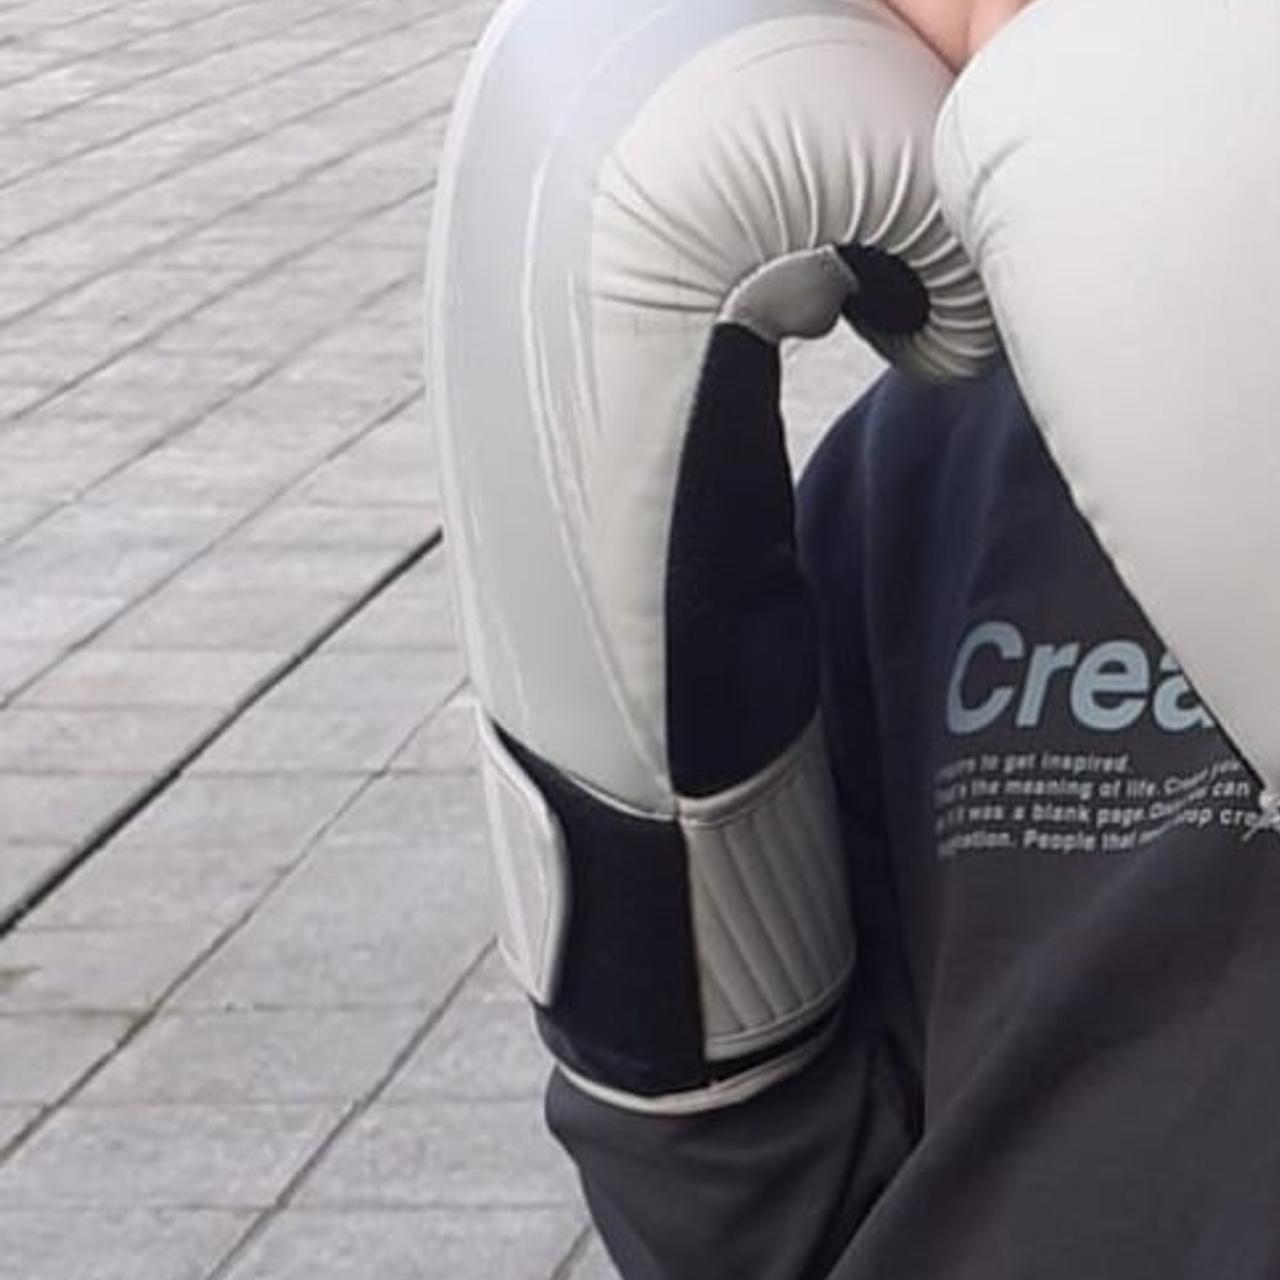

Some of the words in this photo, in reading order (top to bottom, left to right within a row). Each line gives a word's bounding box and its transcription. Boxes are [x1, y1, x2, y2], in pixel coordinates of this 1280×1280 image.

[946, 621, 1215, 735] Crea
[1041, 752, 1132, 775] inspired.
[1005, 777, 1093, 800] meaning
[1098, 780, 1120, 797] of
[1032, 803, 1090, 822] blank
[1023, 829, 1096, 854] People
